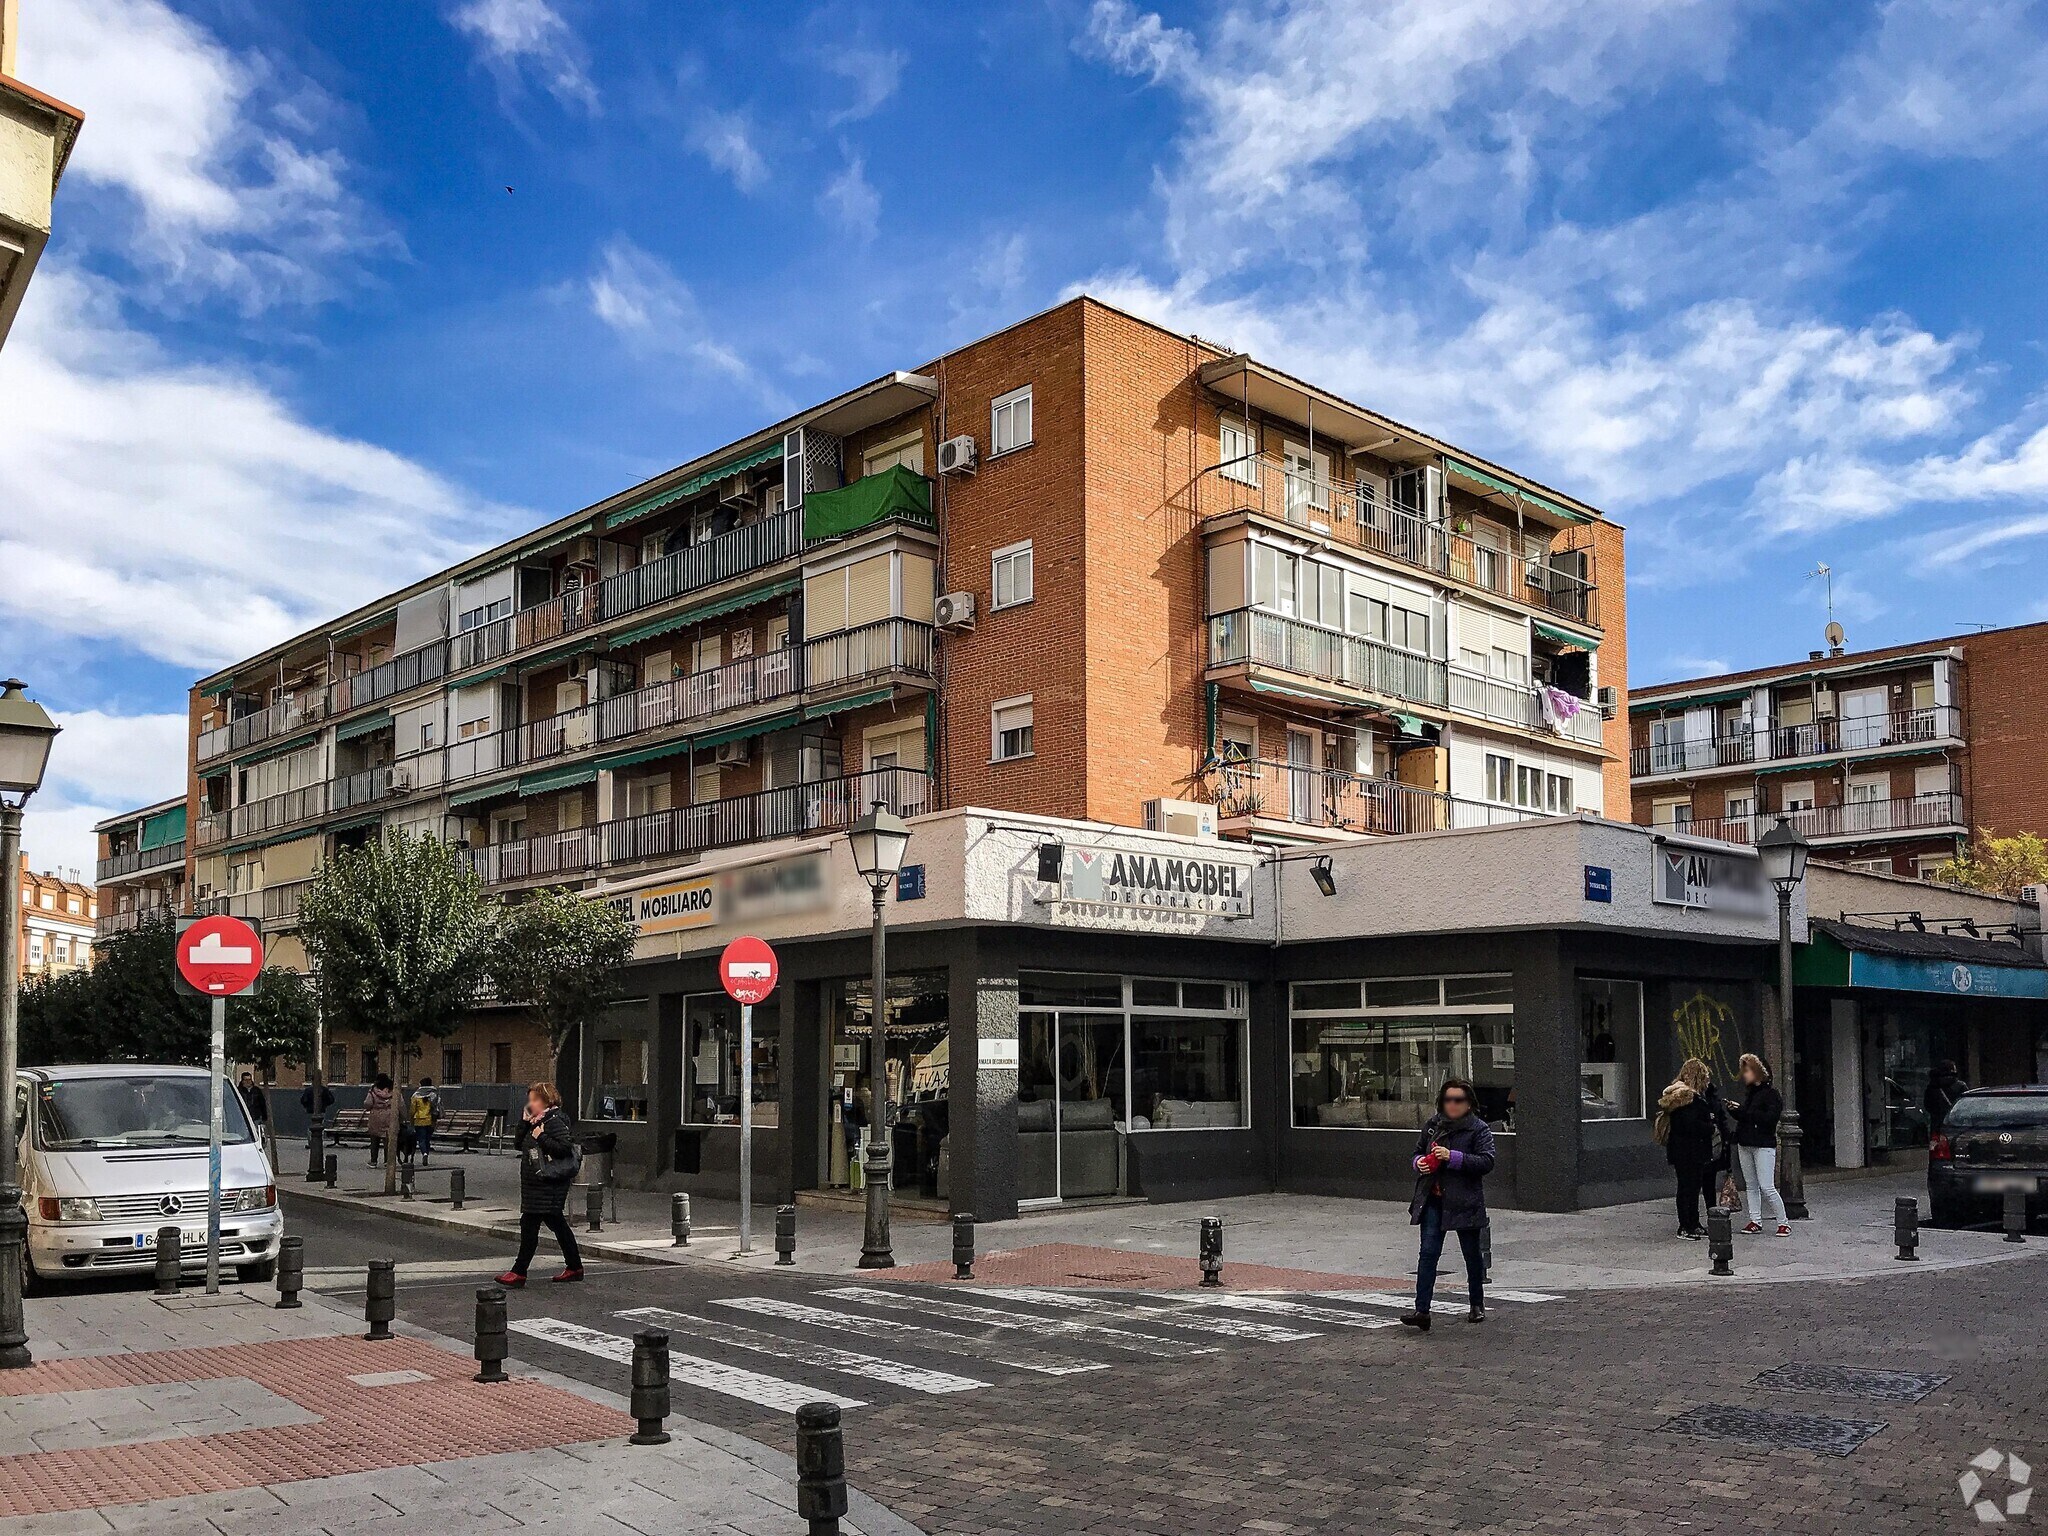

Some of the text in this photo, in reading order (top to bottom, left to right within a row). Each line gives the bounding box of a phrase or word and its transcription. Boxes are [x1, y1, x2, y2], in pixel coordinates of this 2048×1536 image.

[1109, 853, 1242, 899] ANAMOBEL
[640, 887, 713, 920] MOBILIARIO
[182, 1231, 206, 1243] HLK
